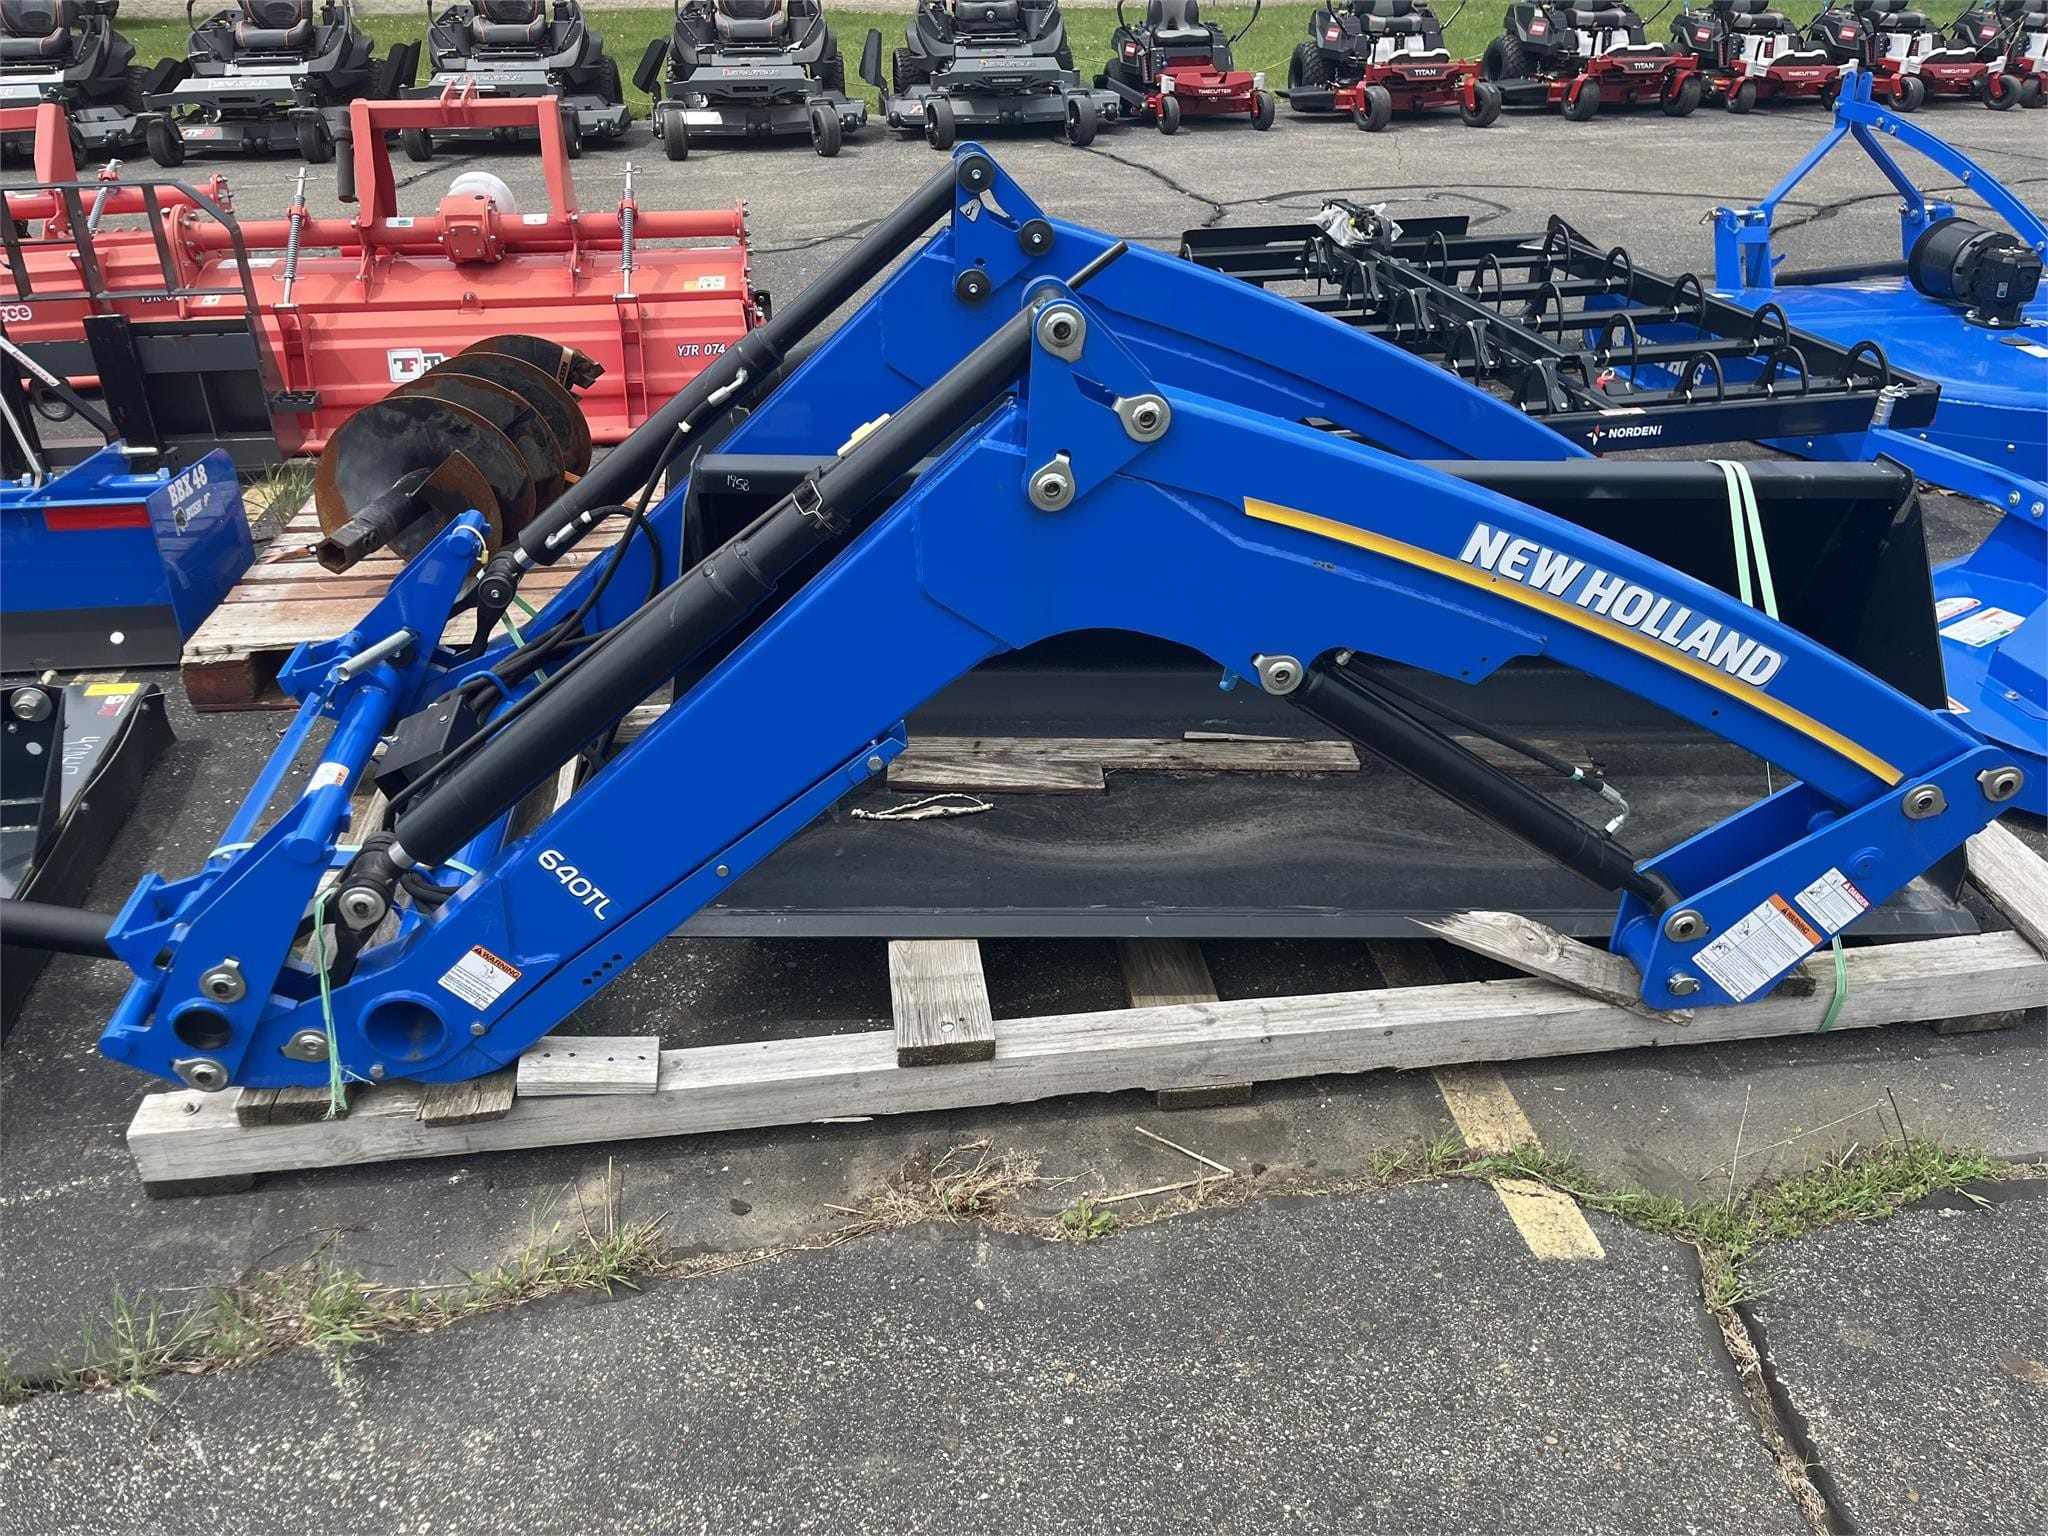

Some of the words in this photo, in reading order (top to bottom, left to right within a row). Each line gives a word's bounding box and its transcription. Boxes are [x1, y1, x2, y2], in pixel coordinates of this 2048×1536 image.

[1414, 68, 1437, 76] TITAN
[1634, 62, 1655, 70] TITAN
[677, 344, 699, 357] YJR
[704, 343, 726, 356] 074
[167, 473, 194, 508] BBX
[192, 463, 208, 489] 48
[727, 474, 750, 492] 1958
[1460, 523, 1586, 598] NEW
[1575, 568, 1783, 687] HOLLAND
[537, 849, 611, 921] 640TL
[1786, 907, 1810, 935] WARNING
[482, 949, 520, 979] WARNING
